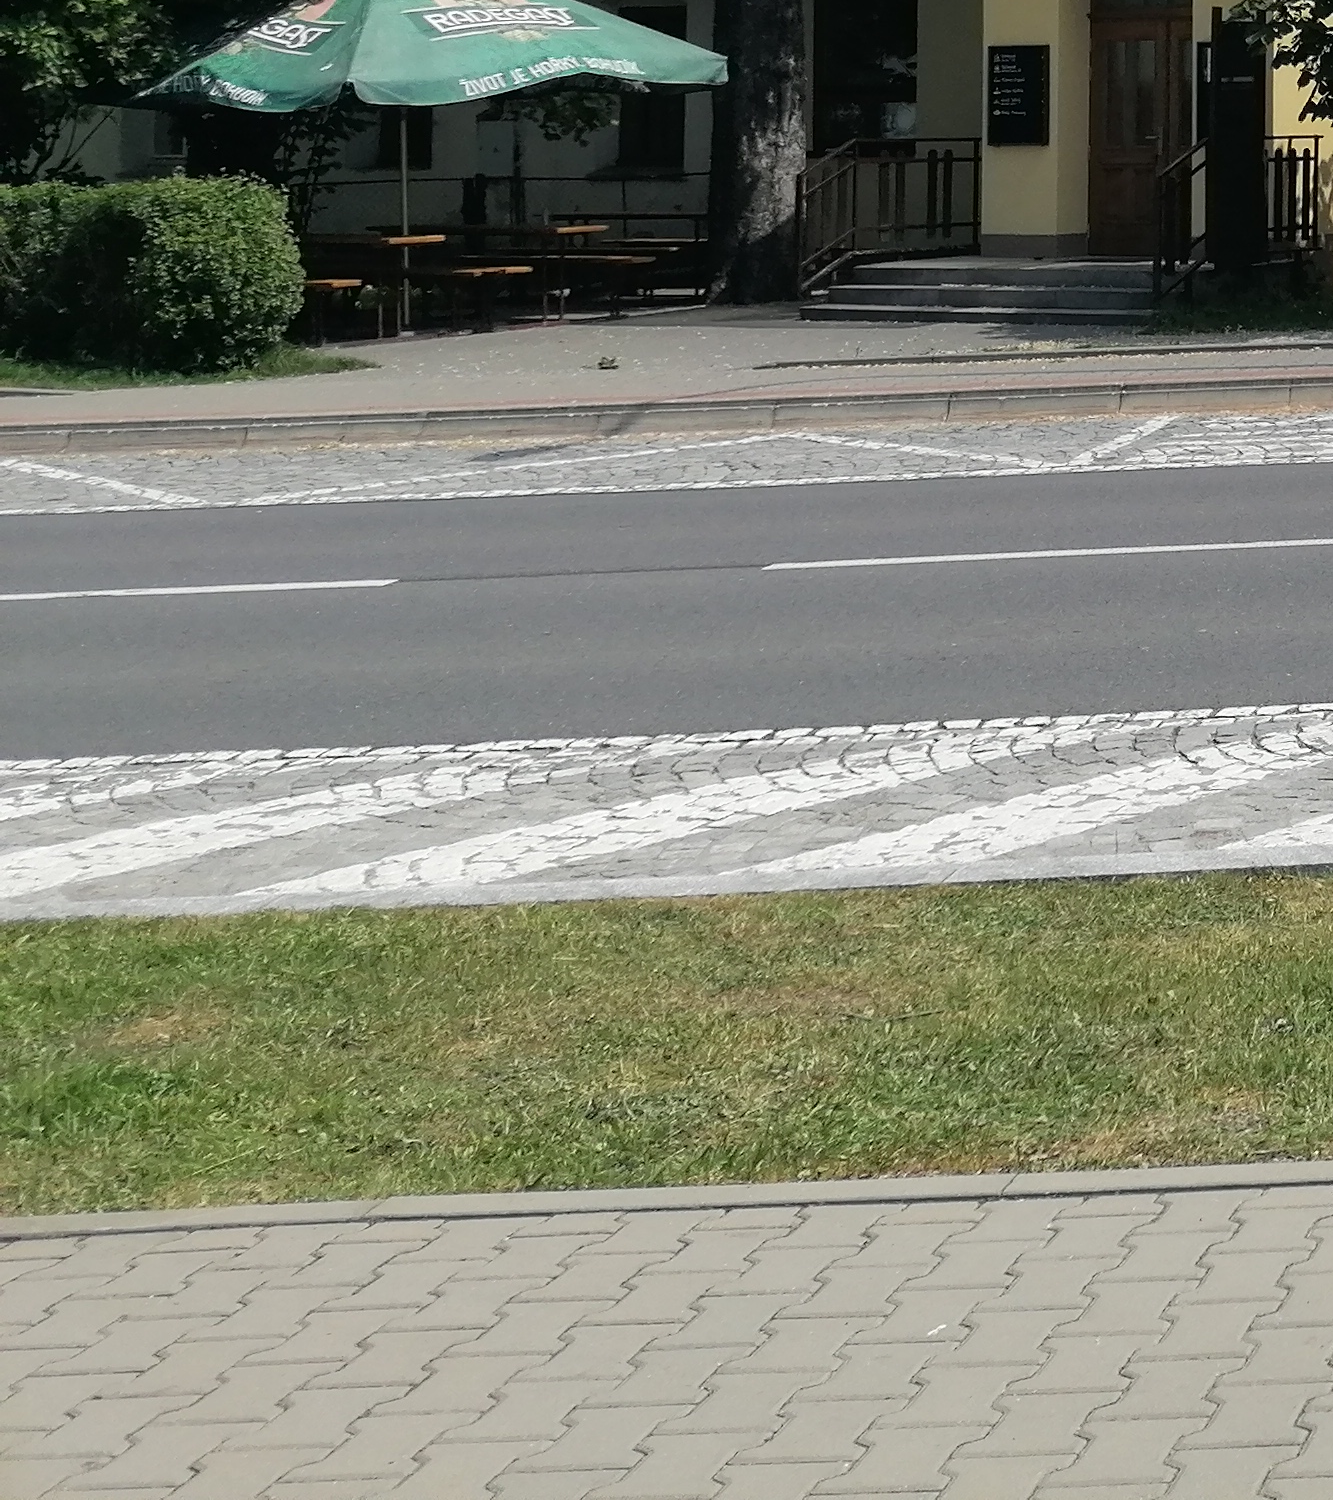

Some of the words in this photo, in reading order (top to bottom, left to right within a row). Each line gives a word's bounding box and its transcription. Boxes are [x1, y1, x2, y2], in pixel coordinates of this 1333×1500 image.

[423, 7, 575, 34] RADEGAST
[459, 73, 508, 97] ŽIVOT
[509, 67, 530, 85] JE
